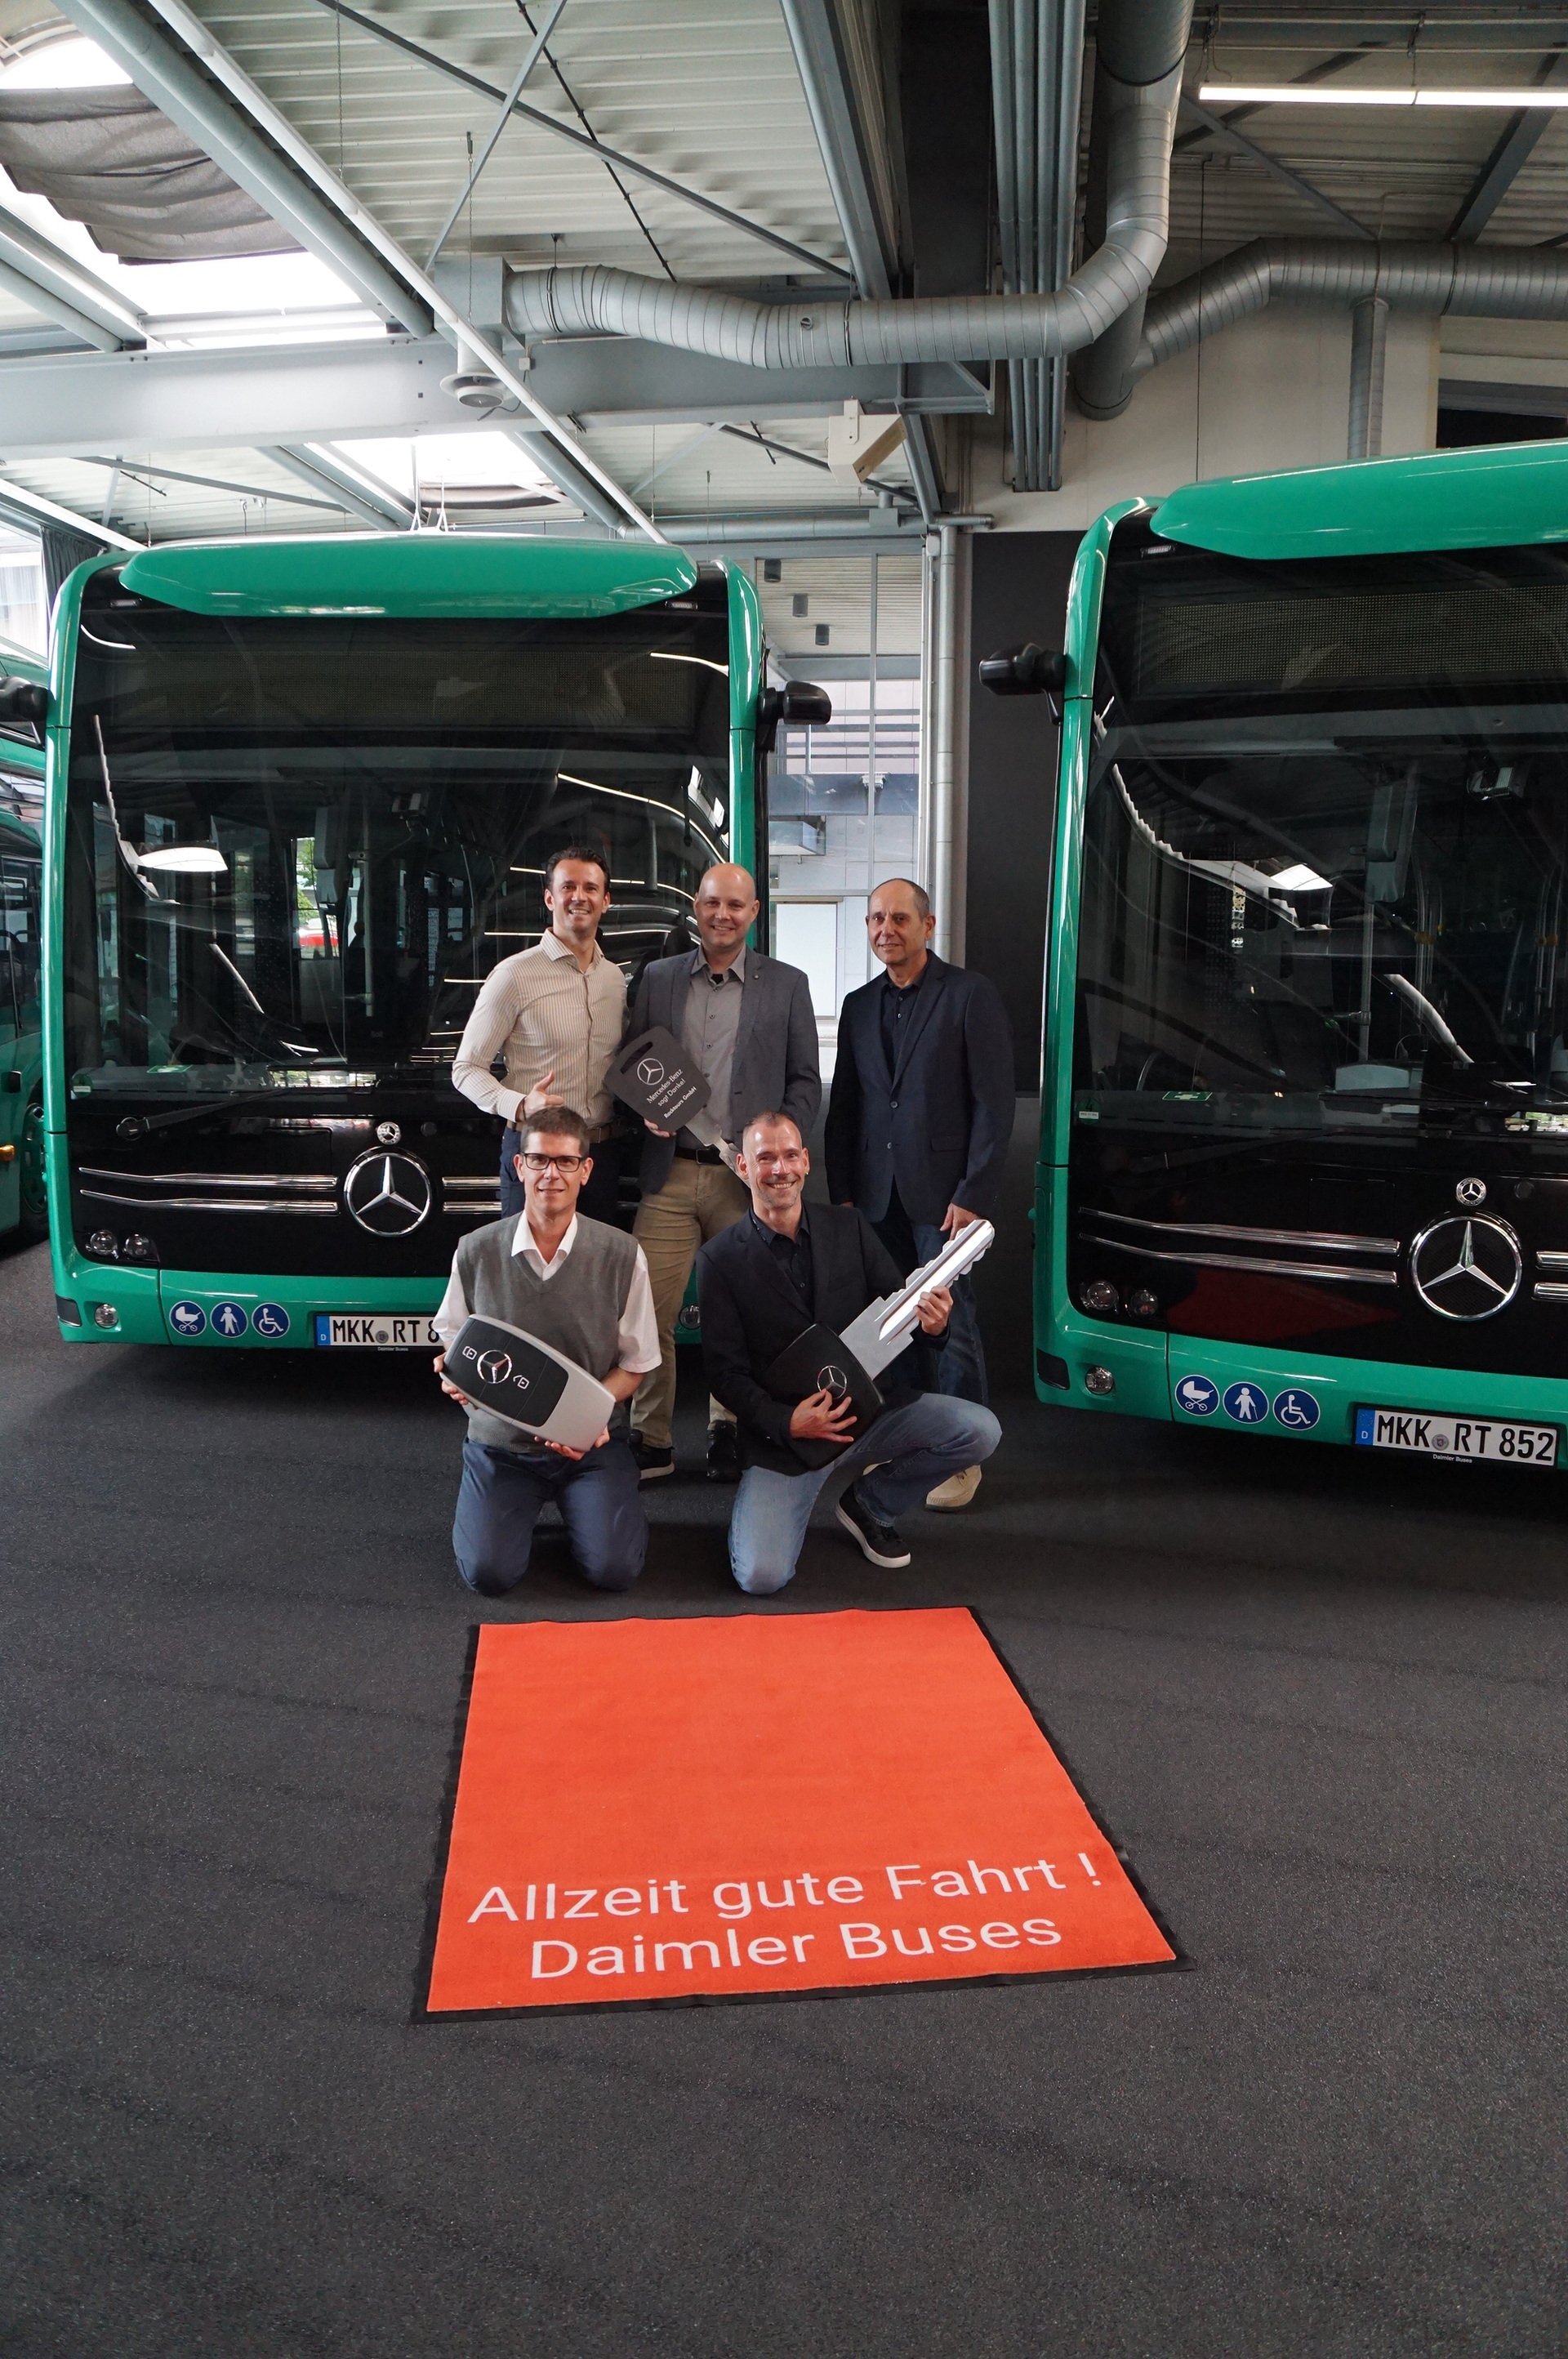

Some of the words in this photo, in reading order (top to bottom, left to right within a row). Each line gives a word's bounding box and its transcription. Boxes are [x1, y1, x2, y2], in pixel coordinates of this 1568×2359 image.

[647, 1069, 683, 1104] Mercedes-Benz
[667, 1078, 685, 1096] Danke!
[683, 1086, 697, 1100] GmbH
[332, 1319, 375, 1343] MKK
[393, 1320, 421, 1343] RT
[1361, 1430, 1368, 1439] D
[1377, 1414, 1432, 1448] MKK
[1454, 1423, 1491, 1454] RT
[1499, 1428, 1554, 1461] 852
[467, 1879, 689, 1923] Allzeit
[713, 1872, 864, 1920] gute
[885, 1859, 1067, 1900] Fahrt
[532, 1929, 814, 1978] Daimler
[840, 1918, 1062, 1960] Buses
